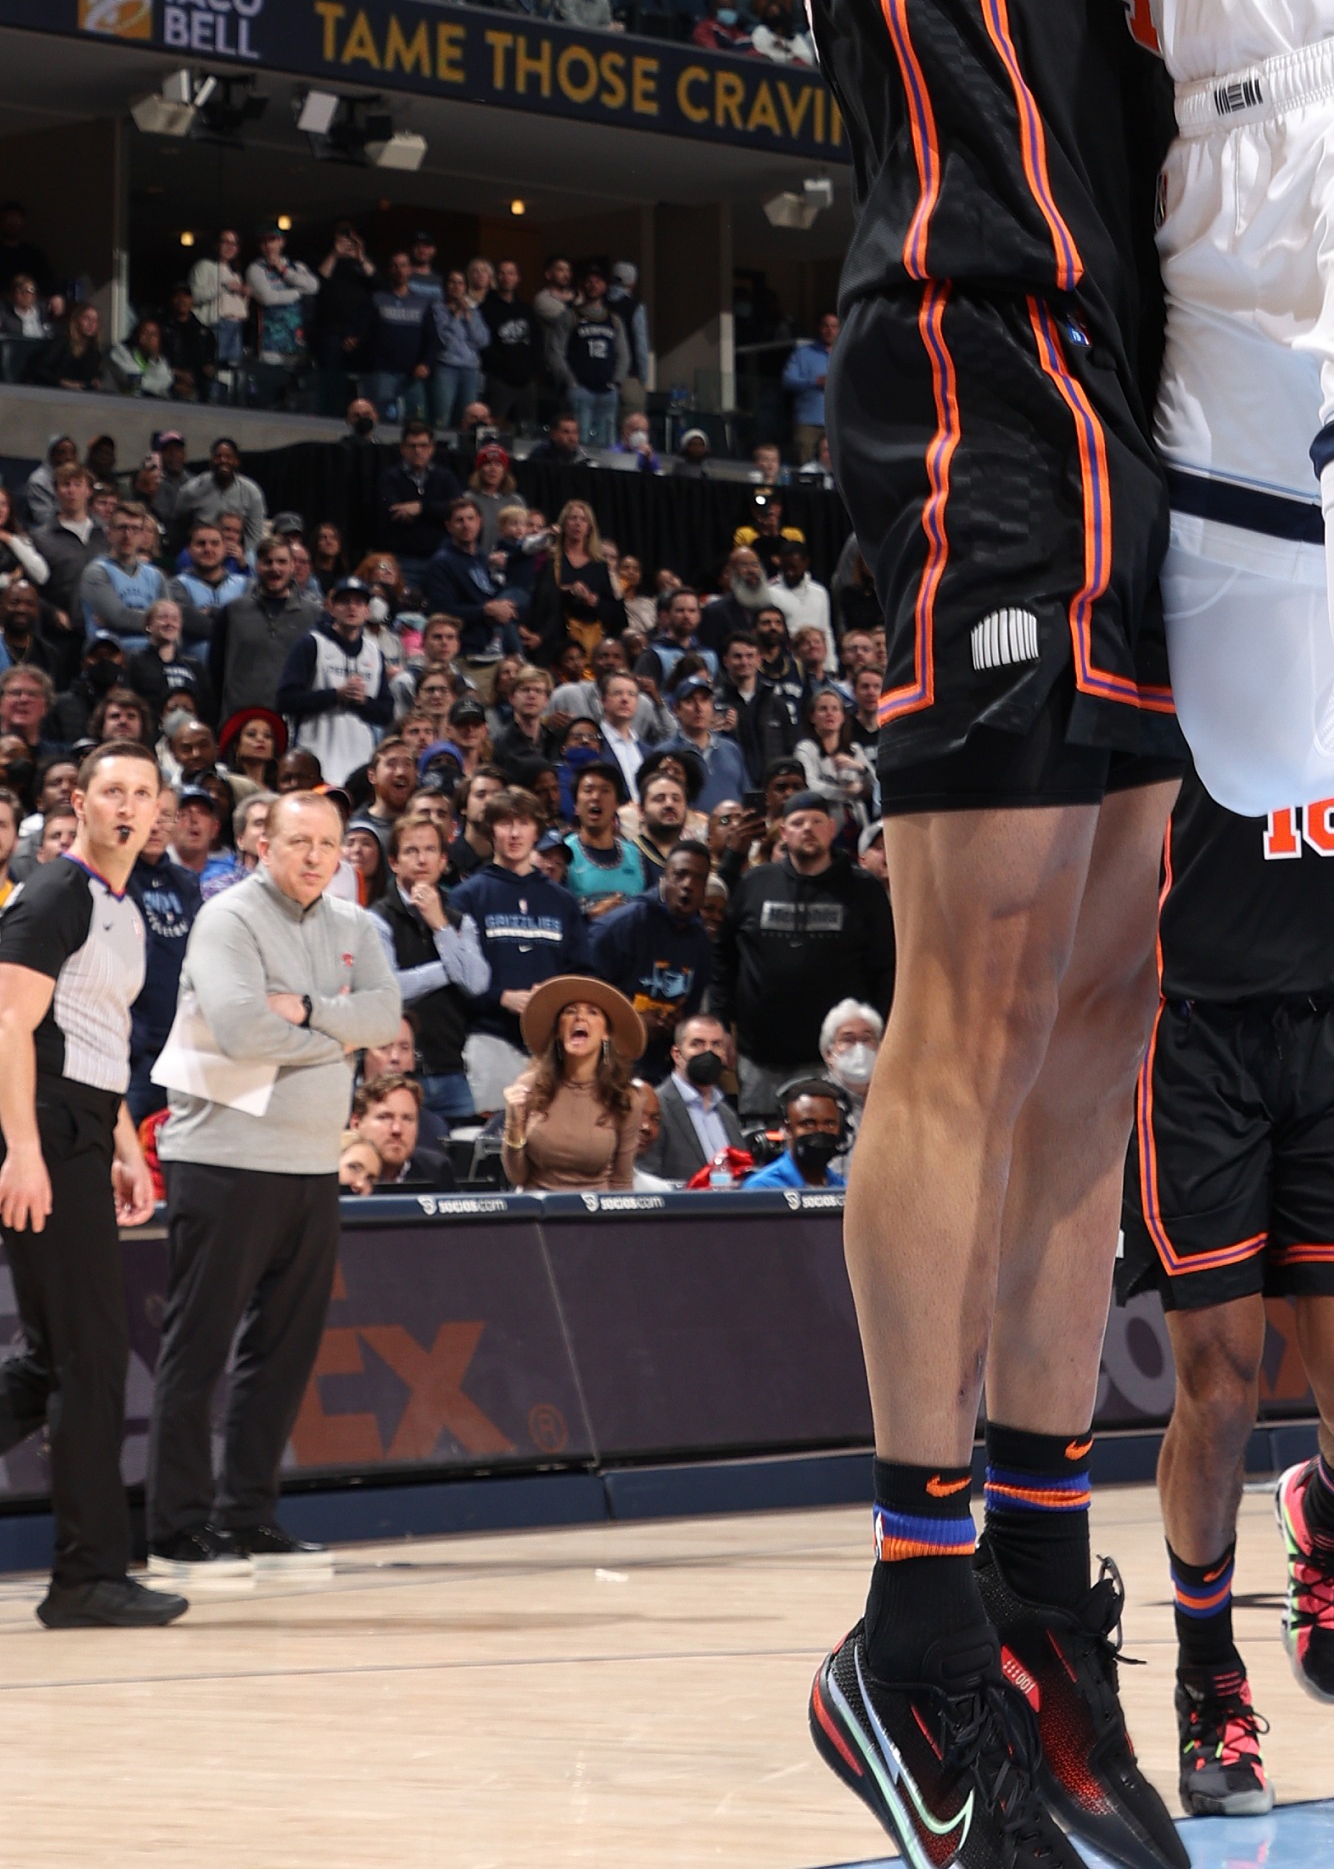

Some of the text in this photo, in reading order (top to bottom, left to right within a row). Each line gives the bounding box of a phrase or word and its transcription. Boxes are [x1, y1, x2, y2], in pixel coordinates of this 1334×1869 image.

[163, 5, 260, 61] BELL
[314, 0, 467, 84] TAME
[484, 29, 661, 117] THOSE
